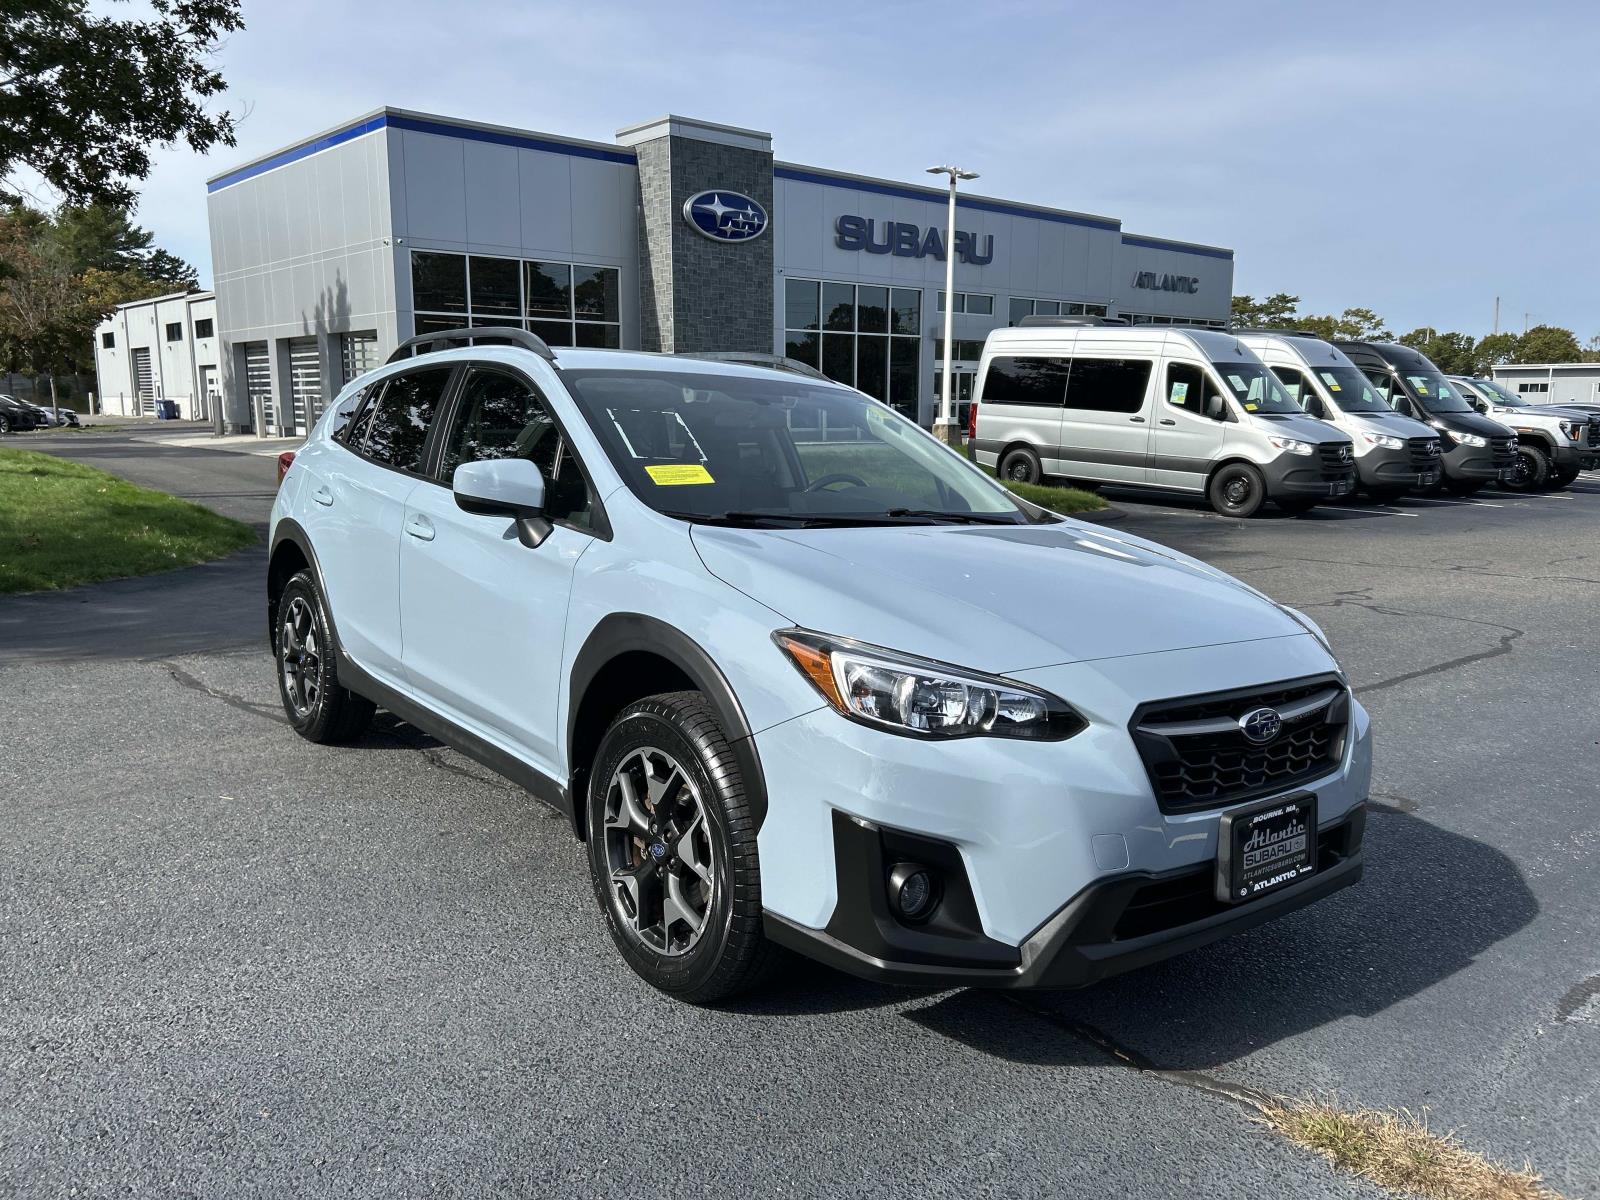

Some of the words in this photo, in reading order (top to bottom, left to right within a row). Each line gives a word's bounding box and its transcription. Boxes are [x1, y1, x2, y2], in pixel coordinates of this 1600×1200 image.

[836, 214, 994, 265] SUBARU
[1131, 271, 1200, 294] ATLANTIC
[1243, 819, 1307, 852] Atlantic
[1245, 840, 1292, 867] SUBARU
[1253, 869, 1297, 892] ATLANTIC
